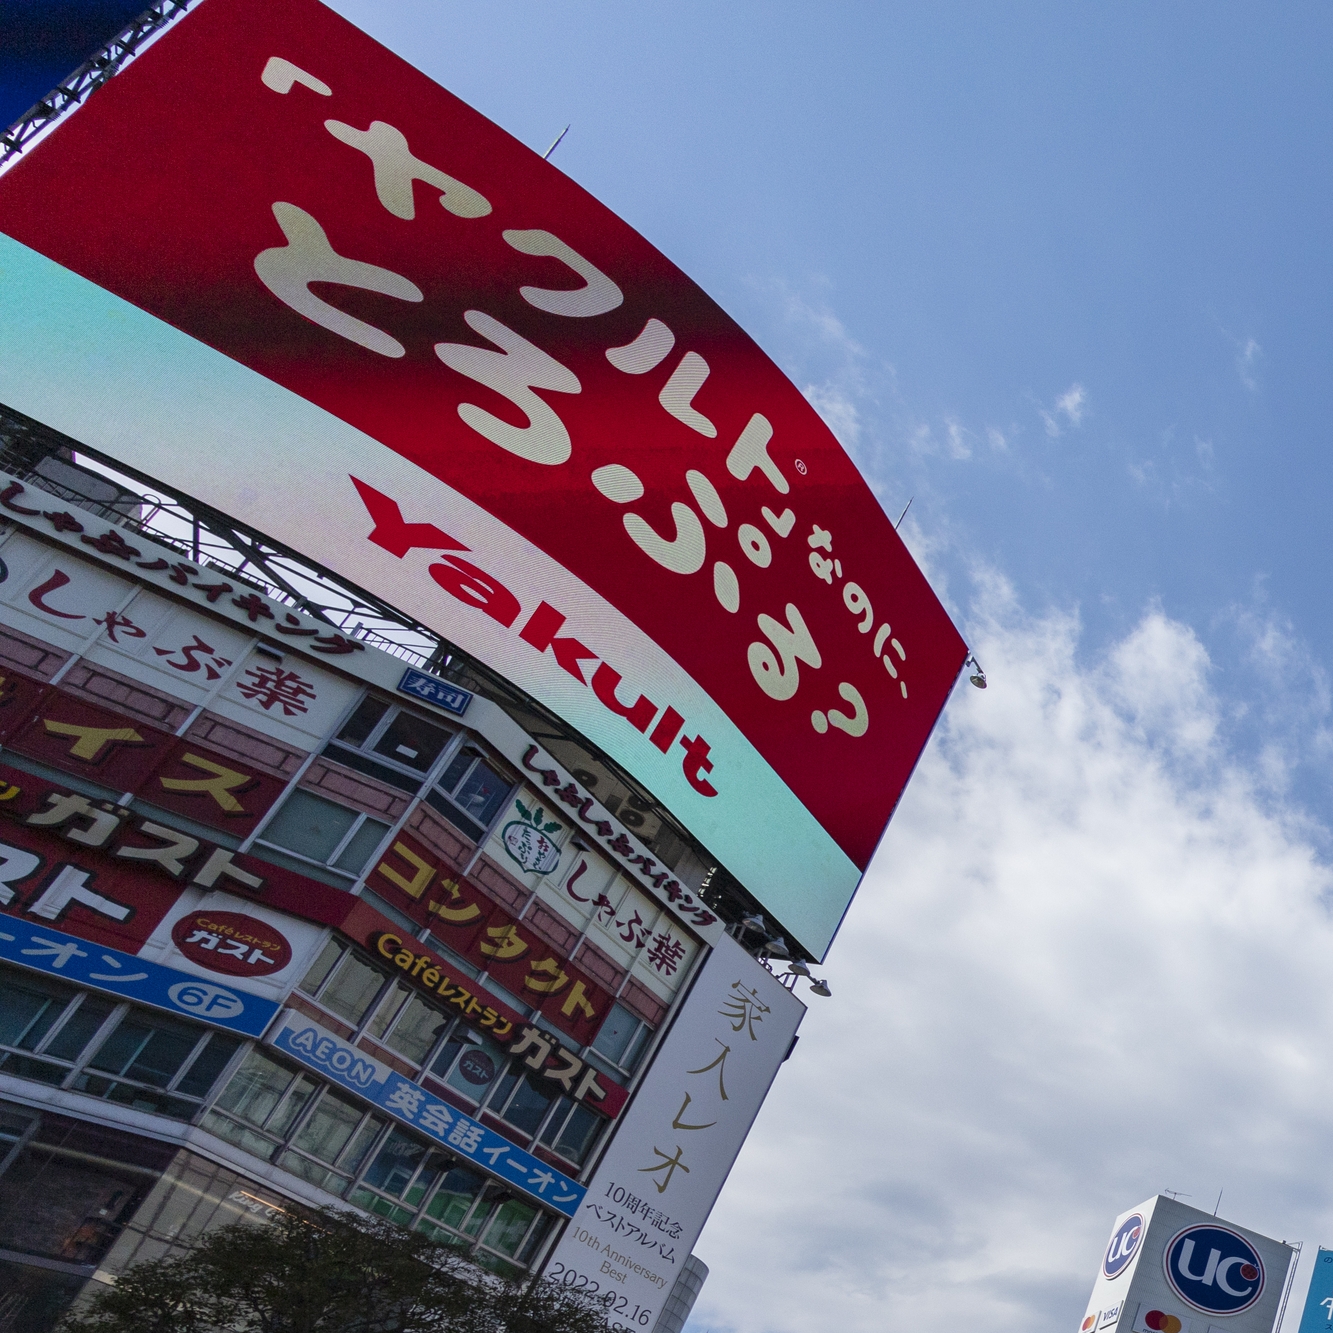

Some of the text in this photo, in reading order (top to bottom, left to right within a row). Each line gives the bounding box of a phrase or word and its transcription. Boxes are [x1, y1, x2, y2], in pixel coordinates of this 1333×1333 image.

[28, 568, 318, 717] しゃぶ葉
[349, 473, 718, 798] Yakult
[405, 672, 469, 711] 寿司
[26, 792, 265, 890] ガスト
[184, 929, 275, 965] ガスト
[378, 841, 599, 1023] コンタクト
[565, 858, 687, 978] しゃぶ葉
[178, 987, 239, 1014] 6F
[509, 1022, 609, 1101] ガスト
[637, 979, 772, 1195] 家入レオ
[294, 1026, 579, 1205] AEON 英会話イーオン
[586, 1203, 676, 1264] ベストアルバム
[603, 1182, 684, 1240] 10周年記念
[572, 1226, 669, 1290] 10th Anniversary
[600, 1260, 628, 1285] Best
[548, 1262, 653, 1327] 2022.02.16
